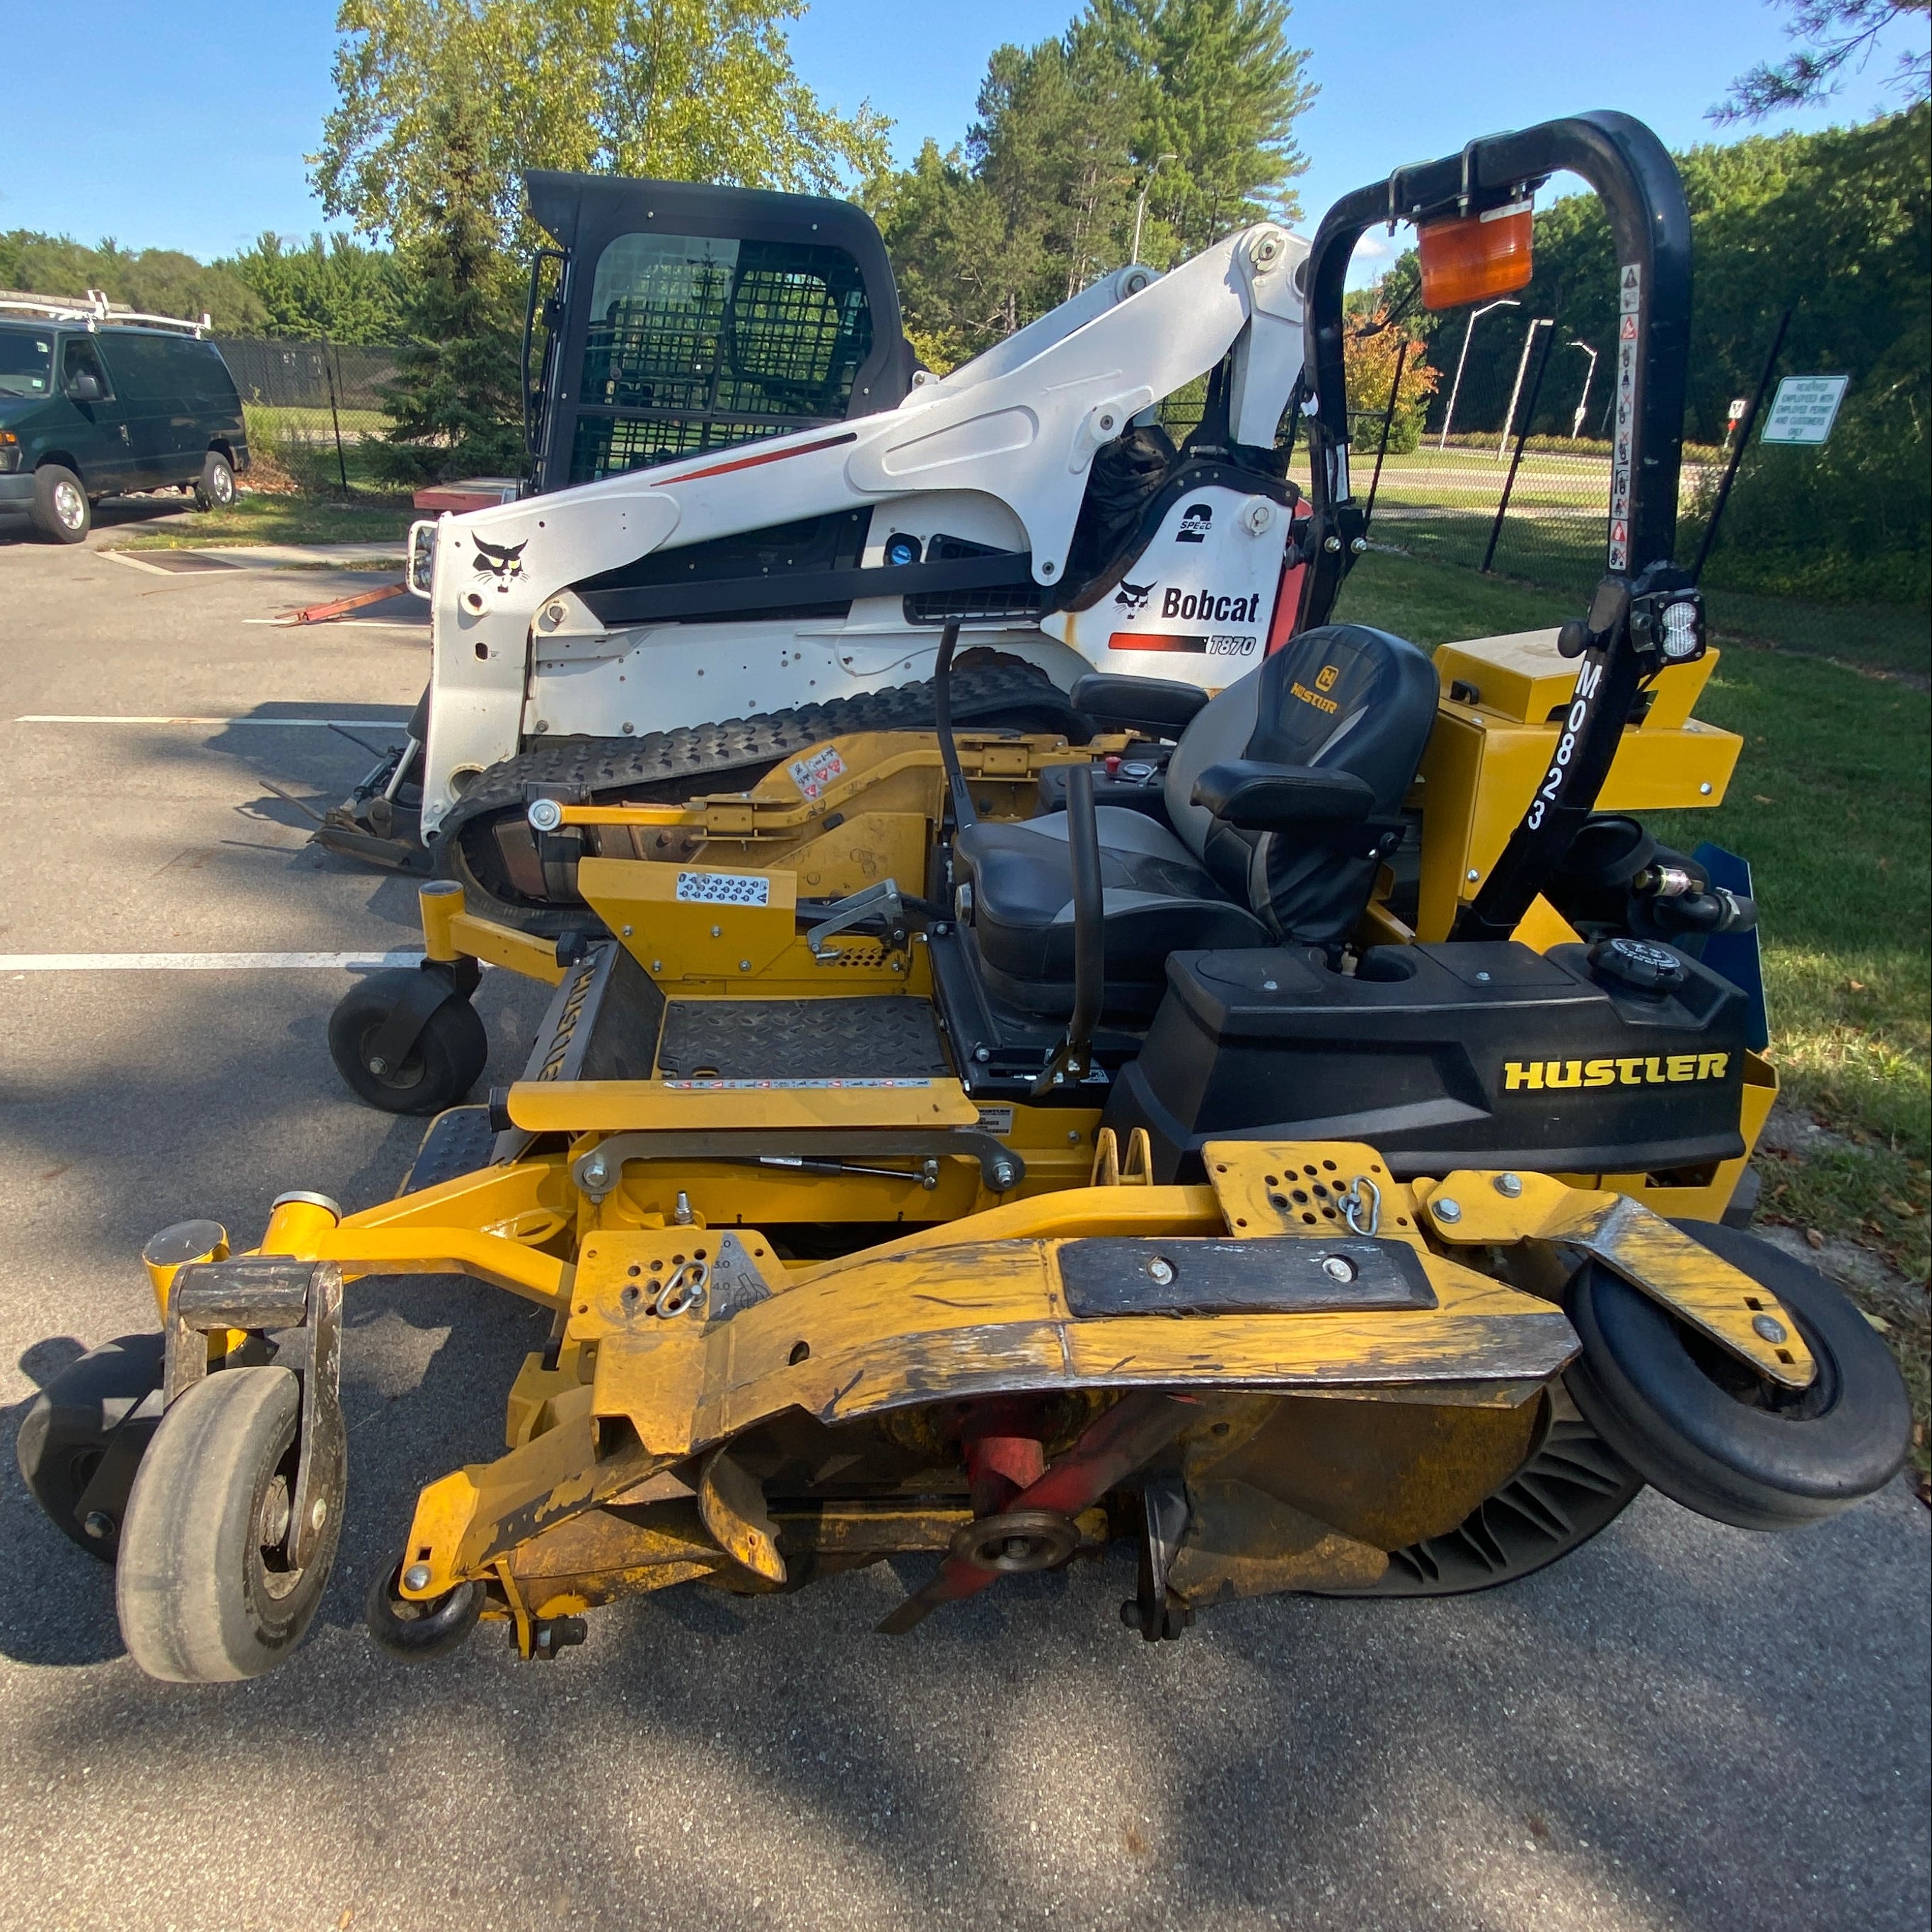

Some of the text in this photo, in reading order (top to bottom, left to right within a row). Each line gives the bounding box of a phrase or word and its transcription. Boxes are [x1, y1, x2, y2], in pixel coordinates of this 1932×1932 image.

[1179, 520, 1212, 531] SPEED
[1161, 587, 1260, 623] Bobcat
[1209, 635, 1256, 656] T870
[1290, 682, 1339, 715] HUSTLER
[1528, 660, 1602, 831] M0823
[1504, 1052, 1729, 1090] HUSTLER
